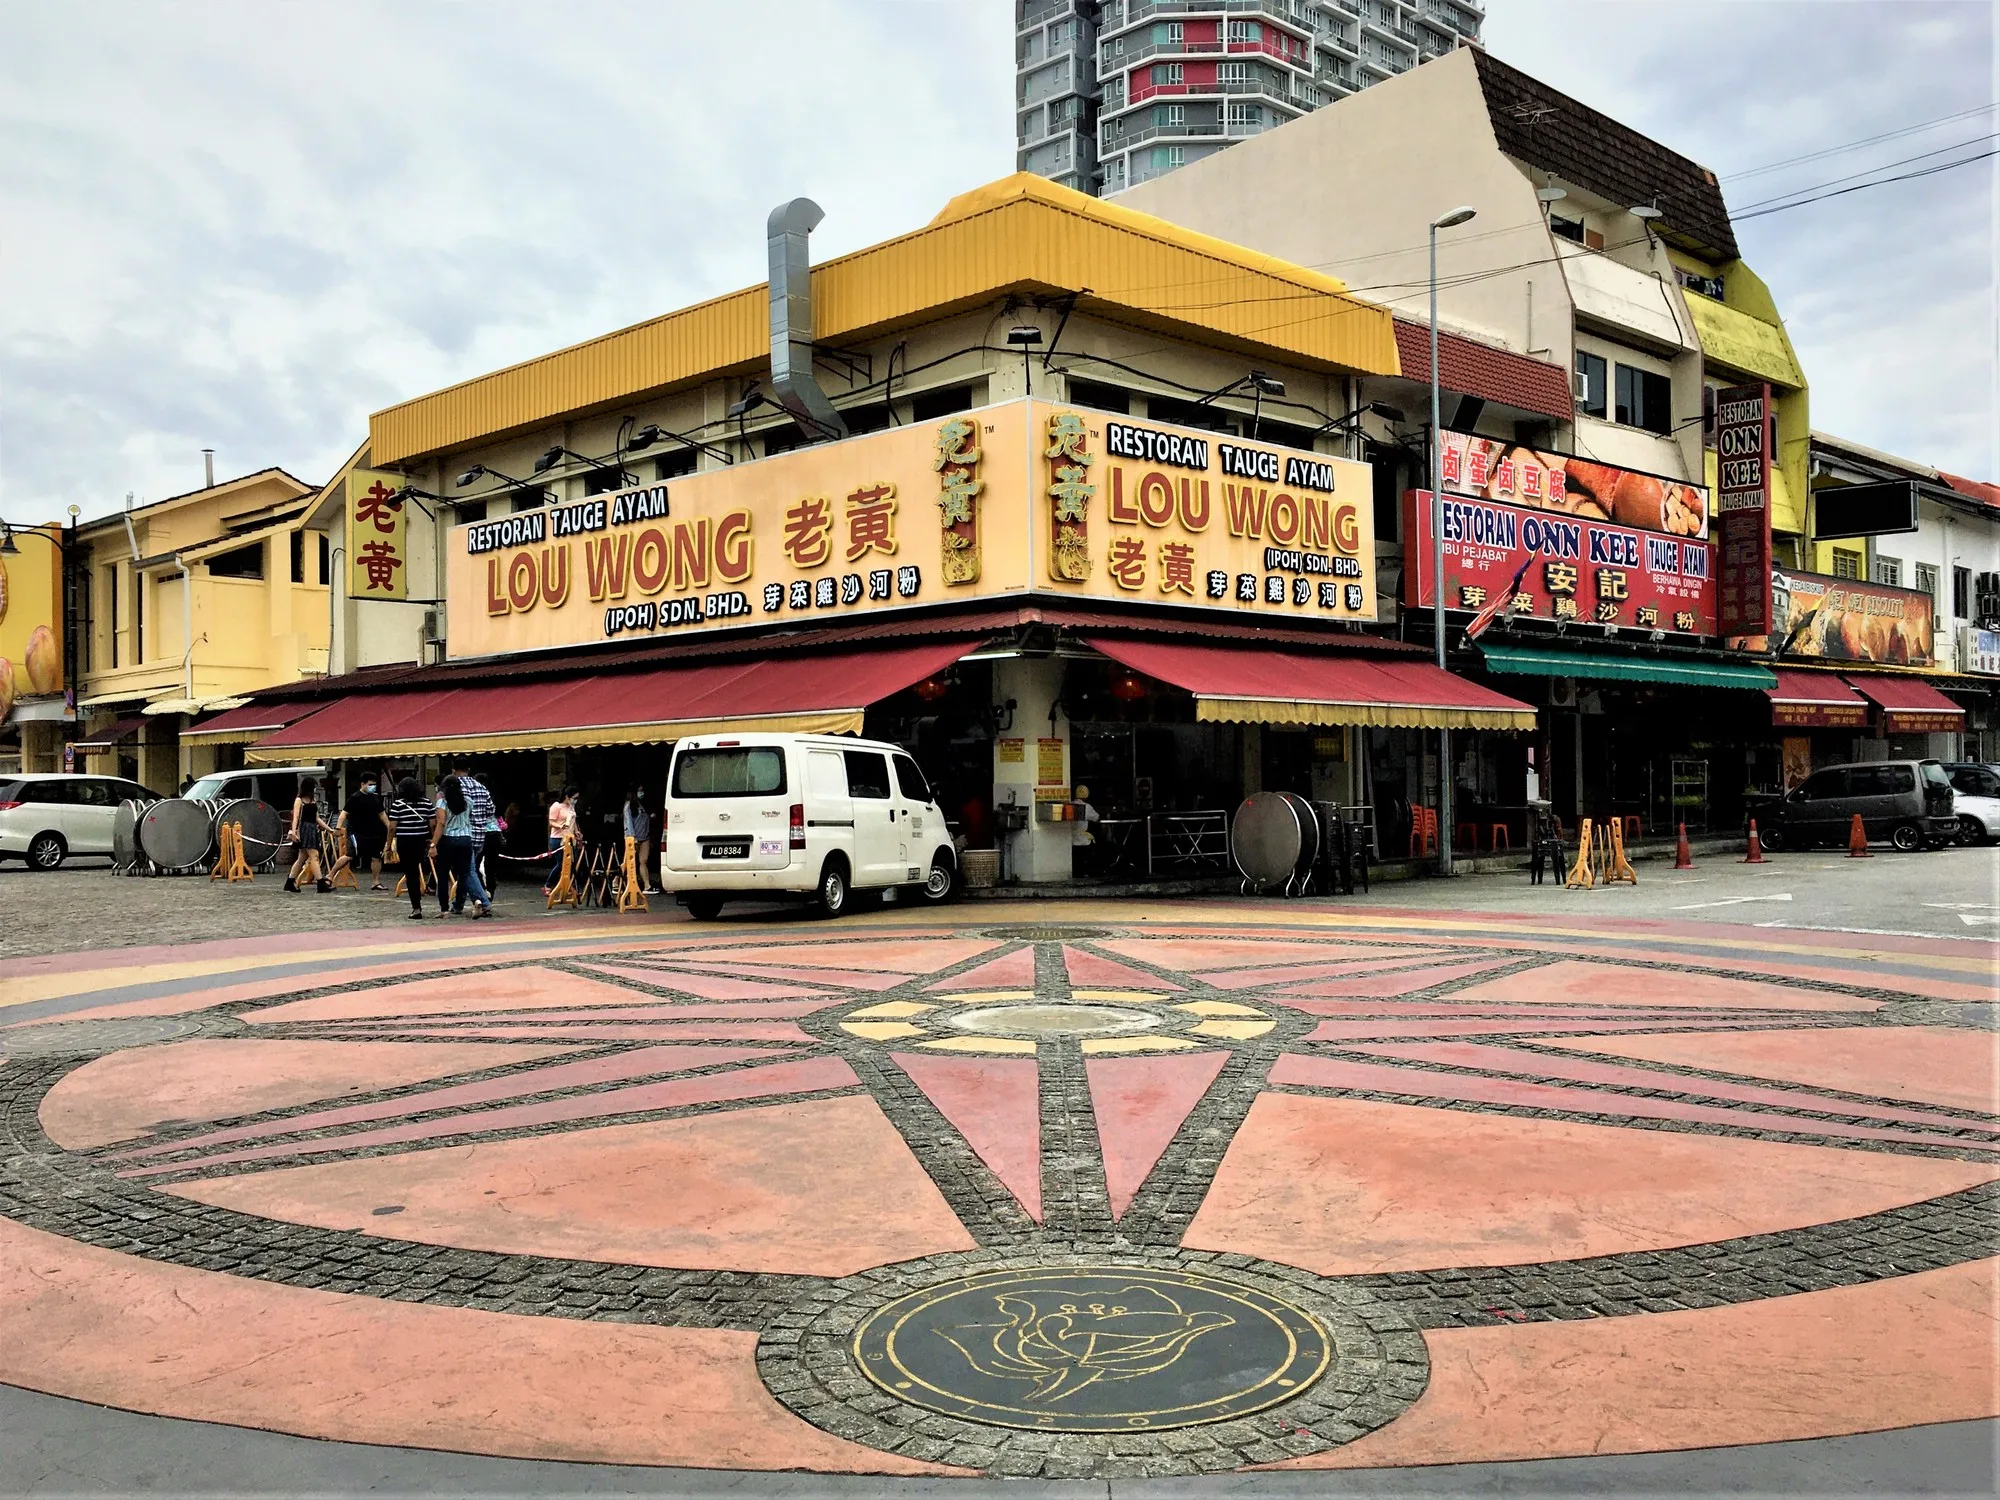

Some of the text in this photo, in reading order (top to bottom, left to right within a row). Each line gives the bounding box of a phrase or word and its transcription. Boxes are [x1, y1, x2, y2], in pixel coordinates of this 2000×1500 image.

[1719, 399, 1763, 425] RESTORAN
[1110, 425, 1334, 491] RESTORAN TAUGE AYAM
[1720, 424, 1762, 457] ONN
[1722, 458, 1761, 489] KEE
[467, 487, 667, 554] RESTORAN TAUGE AYAM
[784, 484, 895, 565] 老黃
[1111, 465, 1360, 552] LOU WONG
[487, 510, 752, 615] LOU WONG
[1112, 538, 1195, 595] 老黃
[1267, 548, 1363, 577] (IPOH) SDN. BHD.
[1463, 545, 1507, 562] PEJABAT
[1523, 517, 1581, 561] ONN
[1588, 529, 1638, 568] KEE
[1645, 535, 1678, 574] (TAUGE
[1682, 544, 1709, 579] AYAM)
[1548, 562, 1629, 599] 安記
[1653, 573, 1682, 587] BERHAWA
[604, 592, 749, 633] (IPOH) SDN. BHD.
[724, 847, 742, 855] 8384
